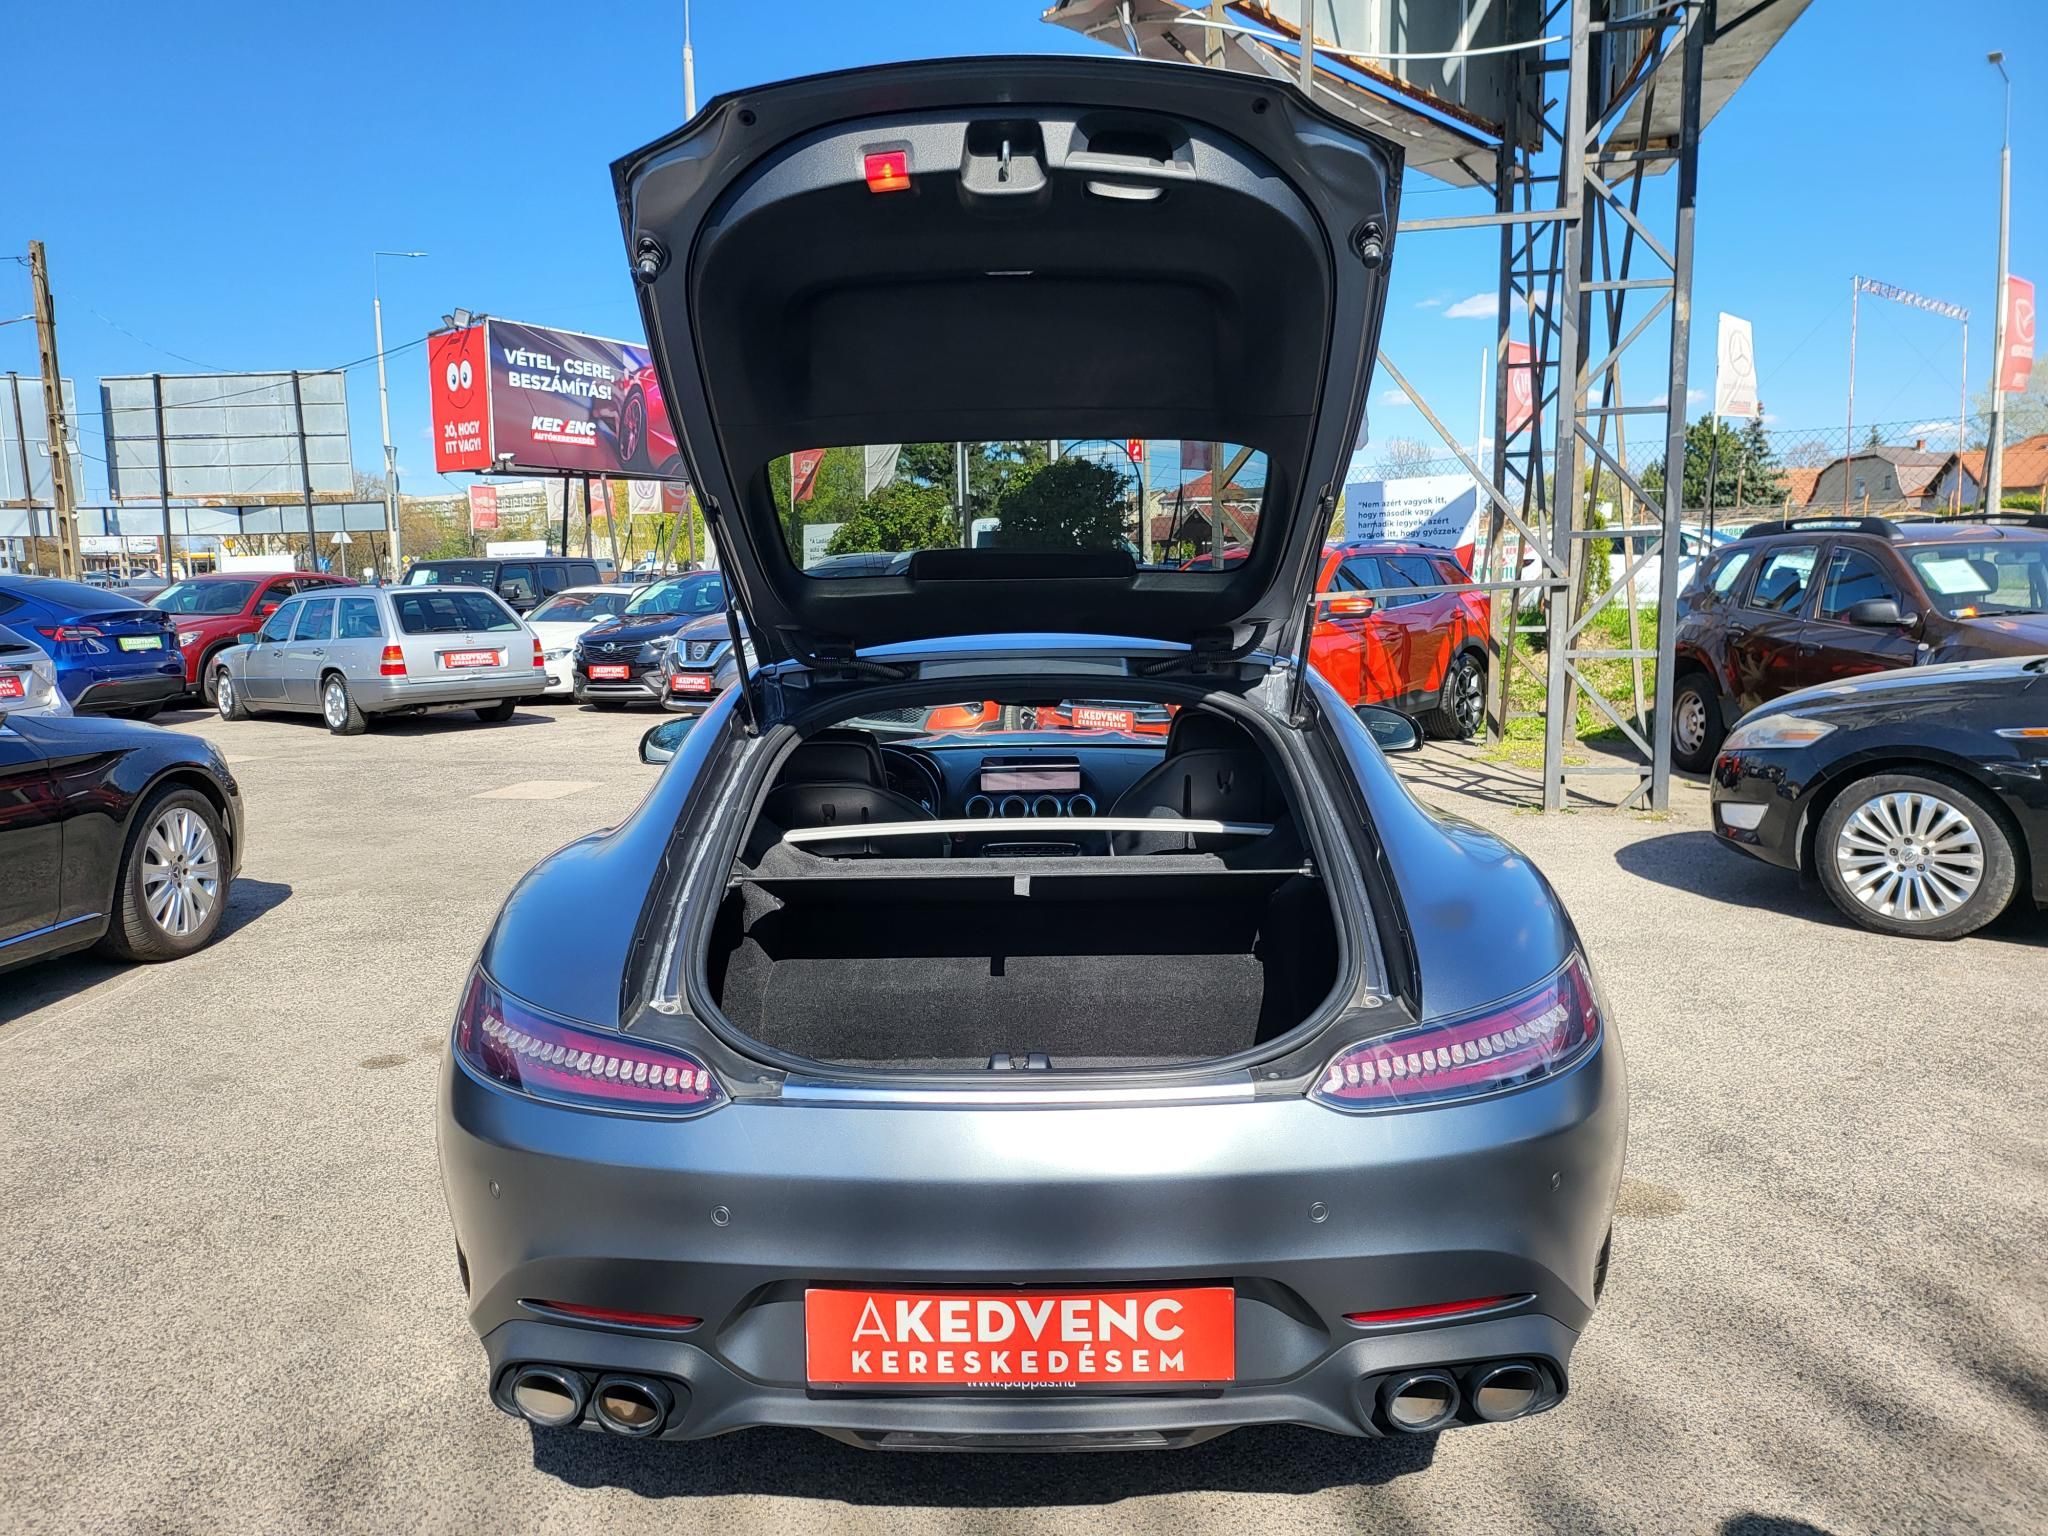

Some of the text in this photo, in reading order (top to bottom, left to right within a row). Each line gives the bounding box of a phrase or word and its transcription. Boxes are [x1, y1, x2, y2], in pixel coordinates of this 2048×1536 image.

[504, 347, 614, 383] VÉTEL, CSERE,
[508, 371, 612, 400] BESZÁMÍTÁS!
[444, 420, 480, 439] JÓ, HOGY
[445, 436, 482, 454] ITT VAGY!
[1381, 499, 1402, 507] azért
[1403, 498, 1433, 507] vagyok
[1358, 508, 1435, 520] hogy második vagy
[1358, 519, 1395, 529] harmadik
[1427, 517, 1450, 525] azért
[1357, 530, 1385, 540] vagyok
[1400, 528, 1421, 538] hogy
[852, 1344, 1185, 1374] KERESKEDÉSEM
